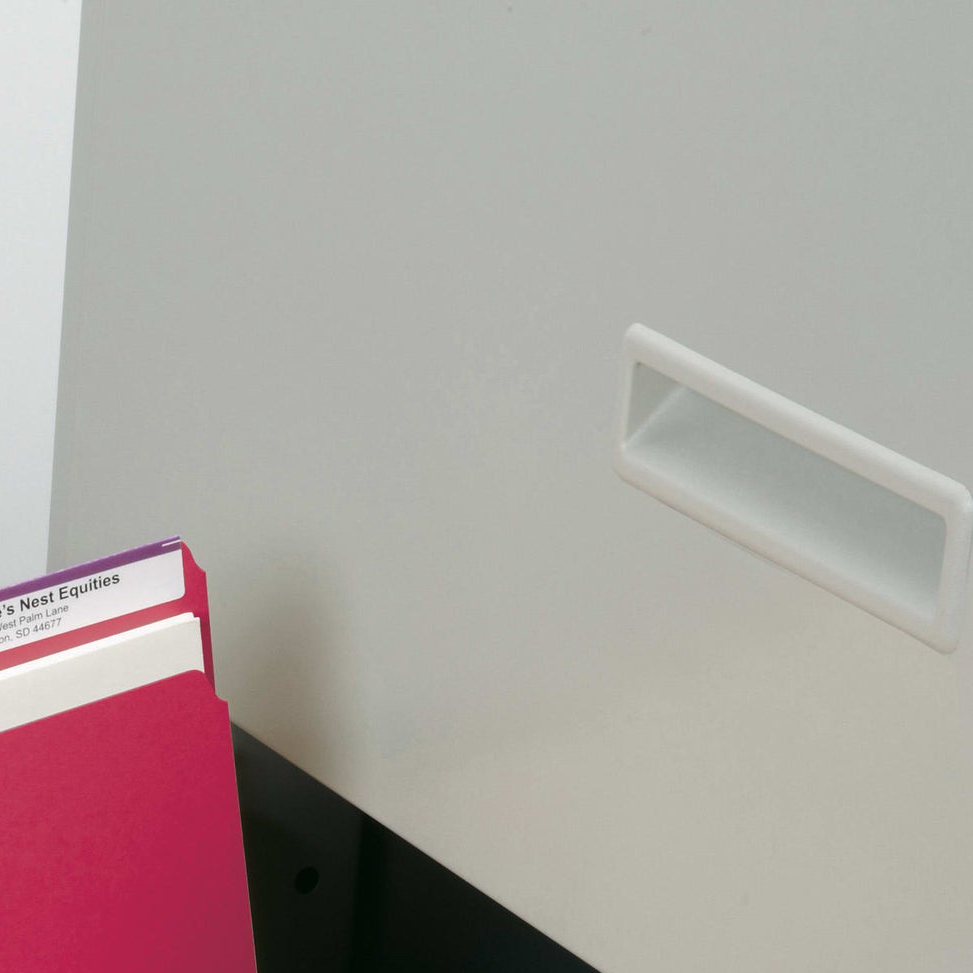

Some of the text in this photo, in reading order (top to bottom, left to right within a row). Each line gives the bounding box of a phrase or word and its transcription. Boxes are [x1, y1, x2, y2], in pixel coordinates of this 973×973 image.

[18, 591, 54, 612] Nest
[57, 573, 121, 600] Equities
[18, 612, 43, 625] Palm
[45, 604, 69, 617] Lane
[14, 627, 30, 638] SD
[32, 617, 62, 633] 44677
